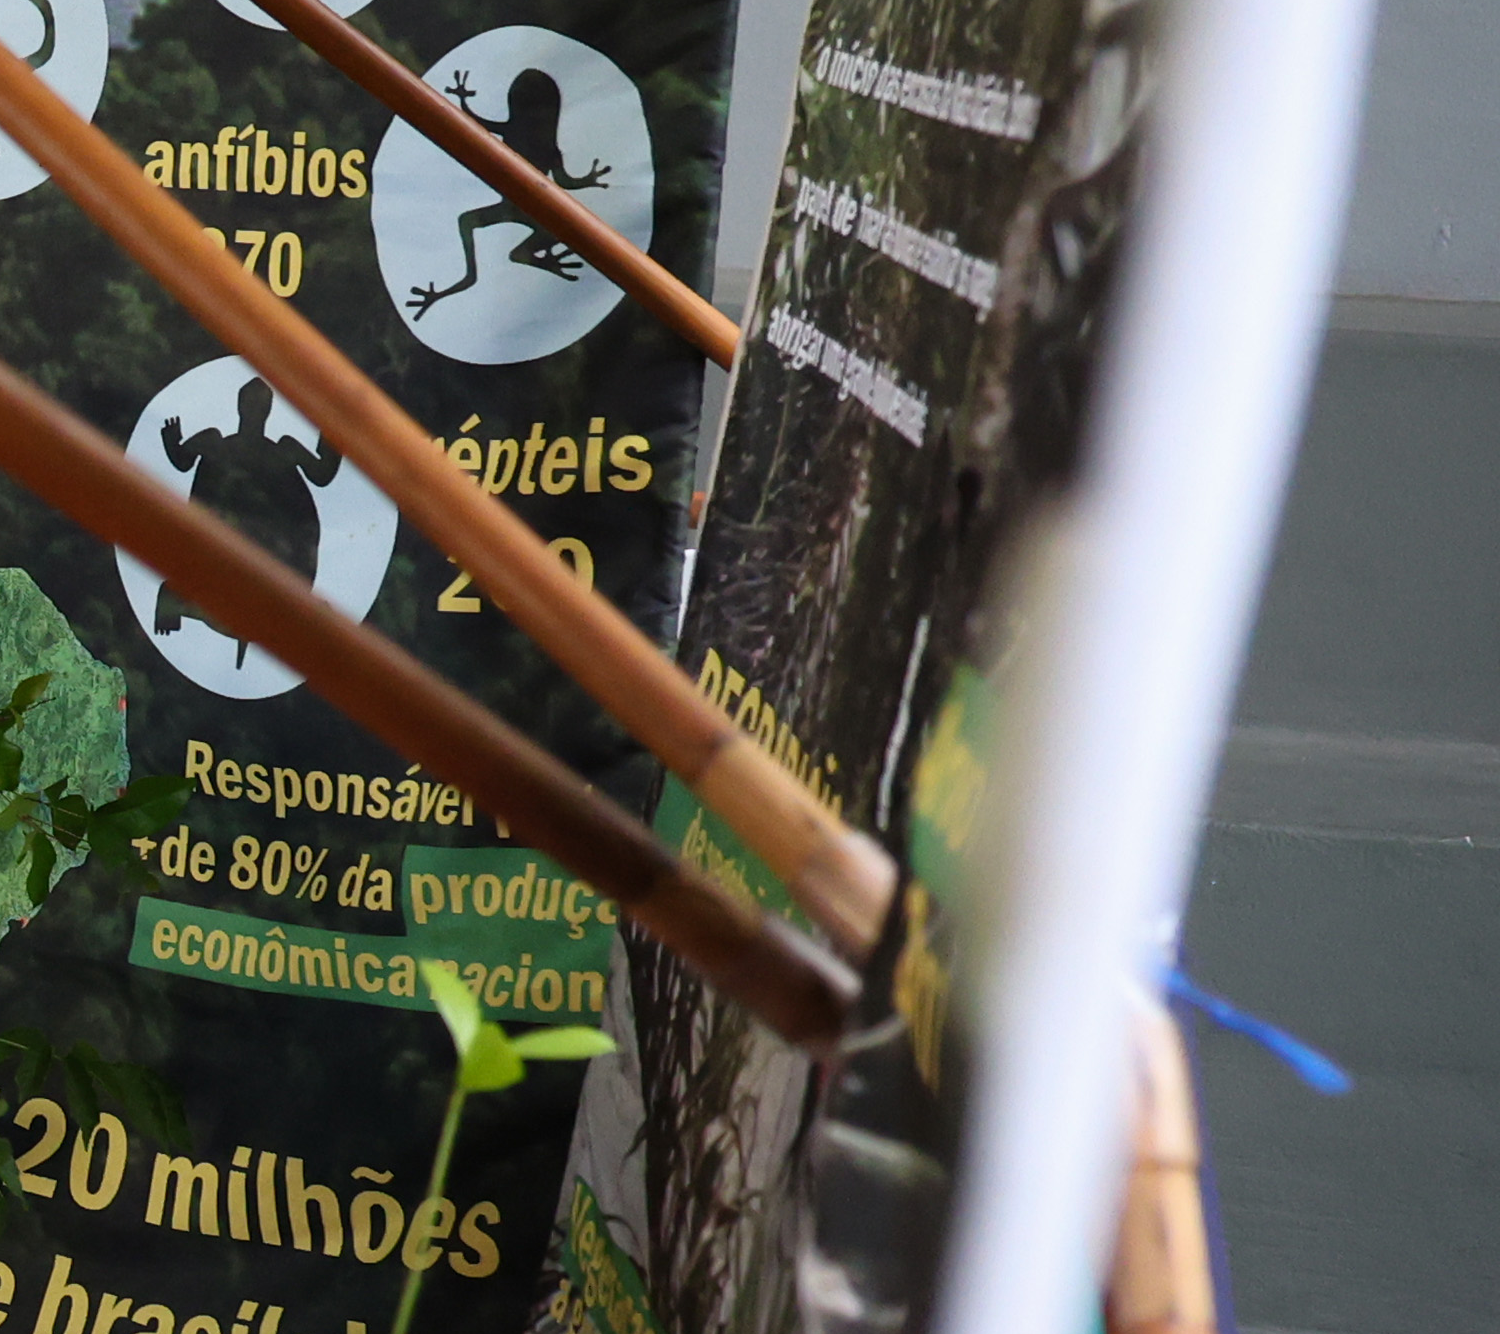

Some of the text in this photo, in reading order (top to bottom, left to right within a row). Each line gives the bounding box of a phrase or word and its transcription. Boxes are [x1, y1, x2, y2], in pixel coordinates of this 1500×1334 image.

[143, 124, 367, 198] anfíbios
[203, 227, 302, 297] 70
[431, 413, 653, 496] épteis
[228, 834, 329, 903] 80%
[337, 853, 393, 911] da
[152, 919, 416, 998] econômica
[145, 1145, 501, 1278] milhões
